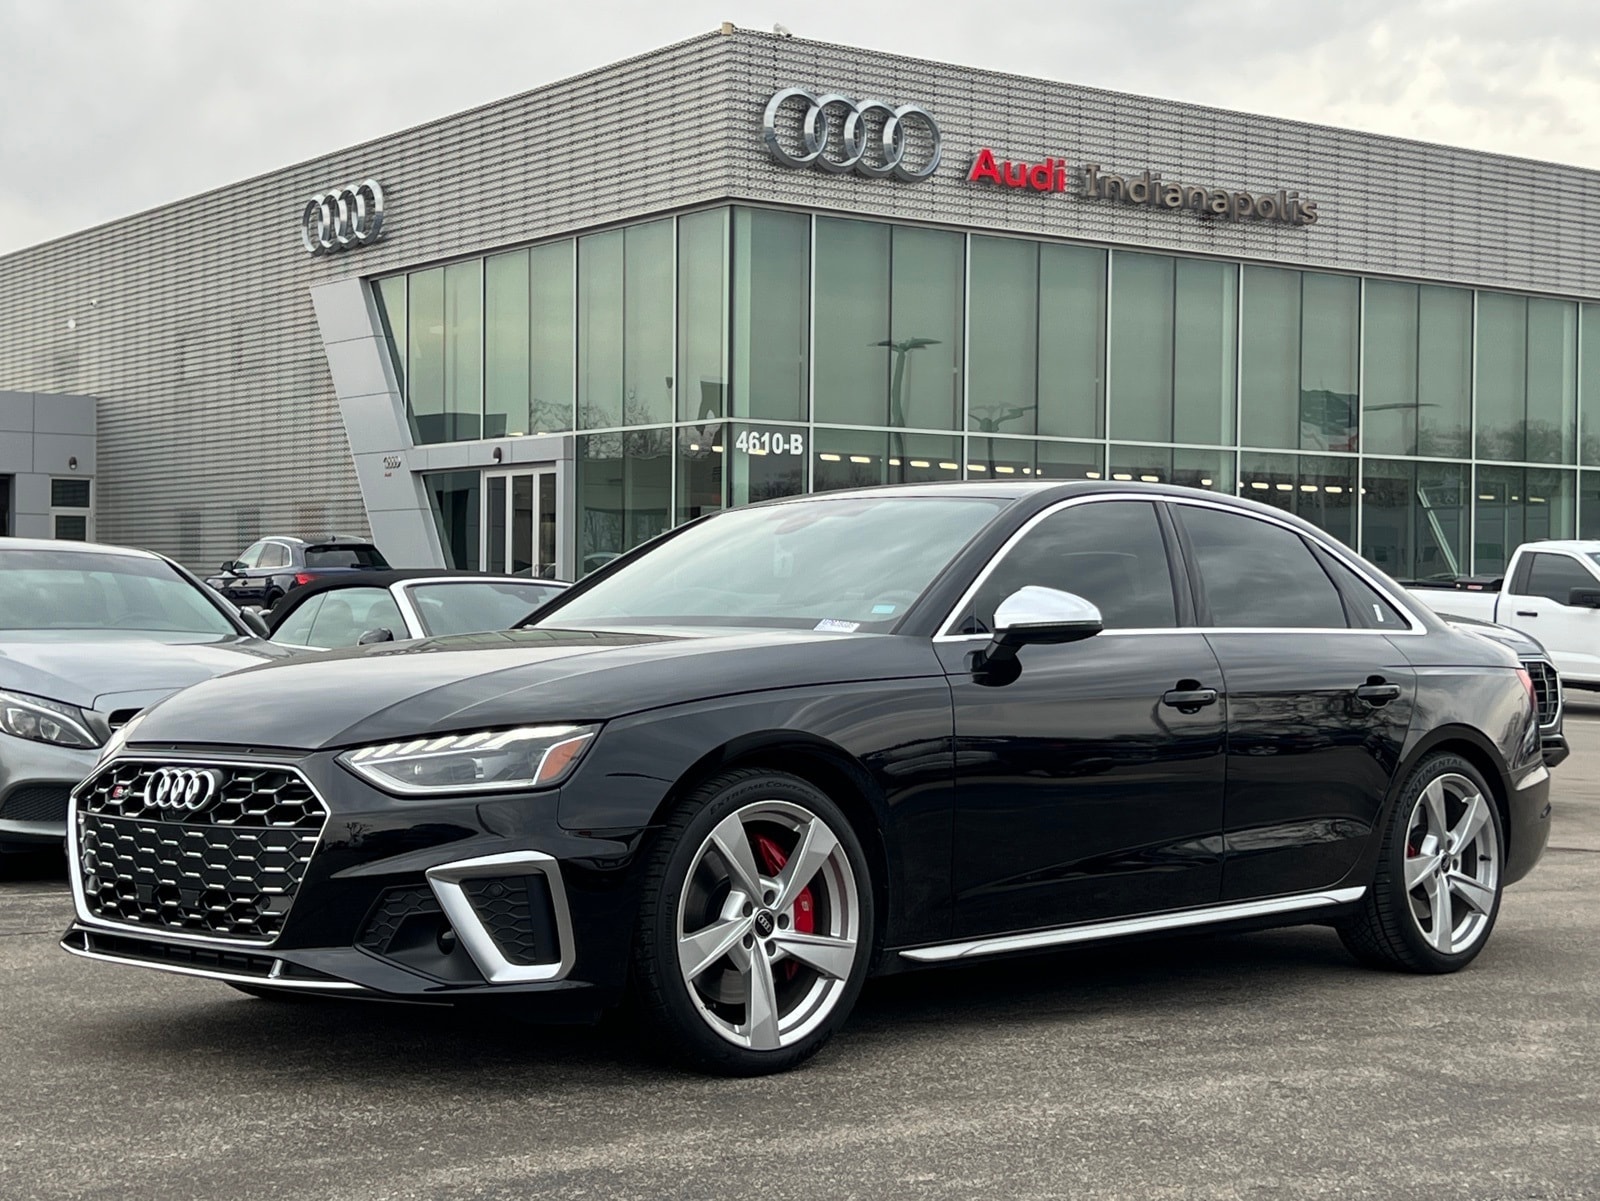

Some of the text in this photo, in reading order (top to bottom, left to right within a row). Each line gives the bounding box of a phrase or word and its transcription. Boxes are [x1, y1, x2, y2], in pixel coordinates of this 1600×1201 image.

[966, 147, 1319, 226] Audi Indianapolis
[736, 431, 803, 455] 4610-B
